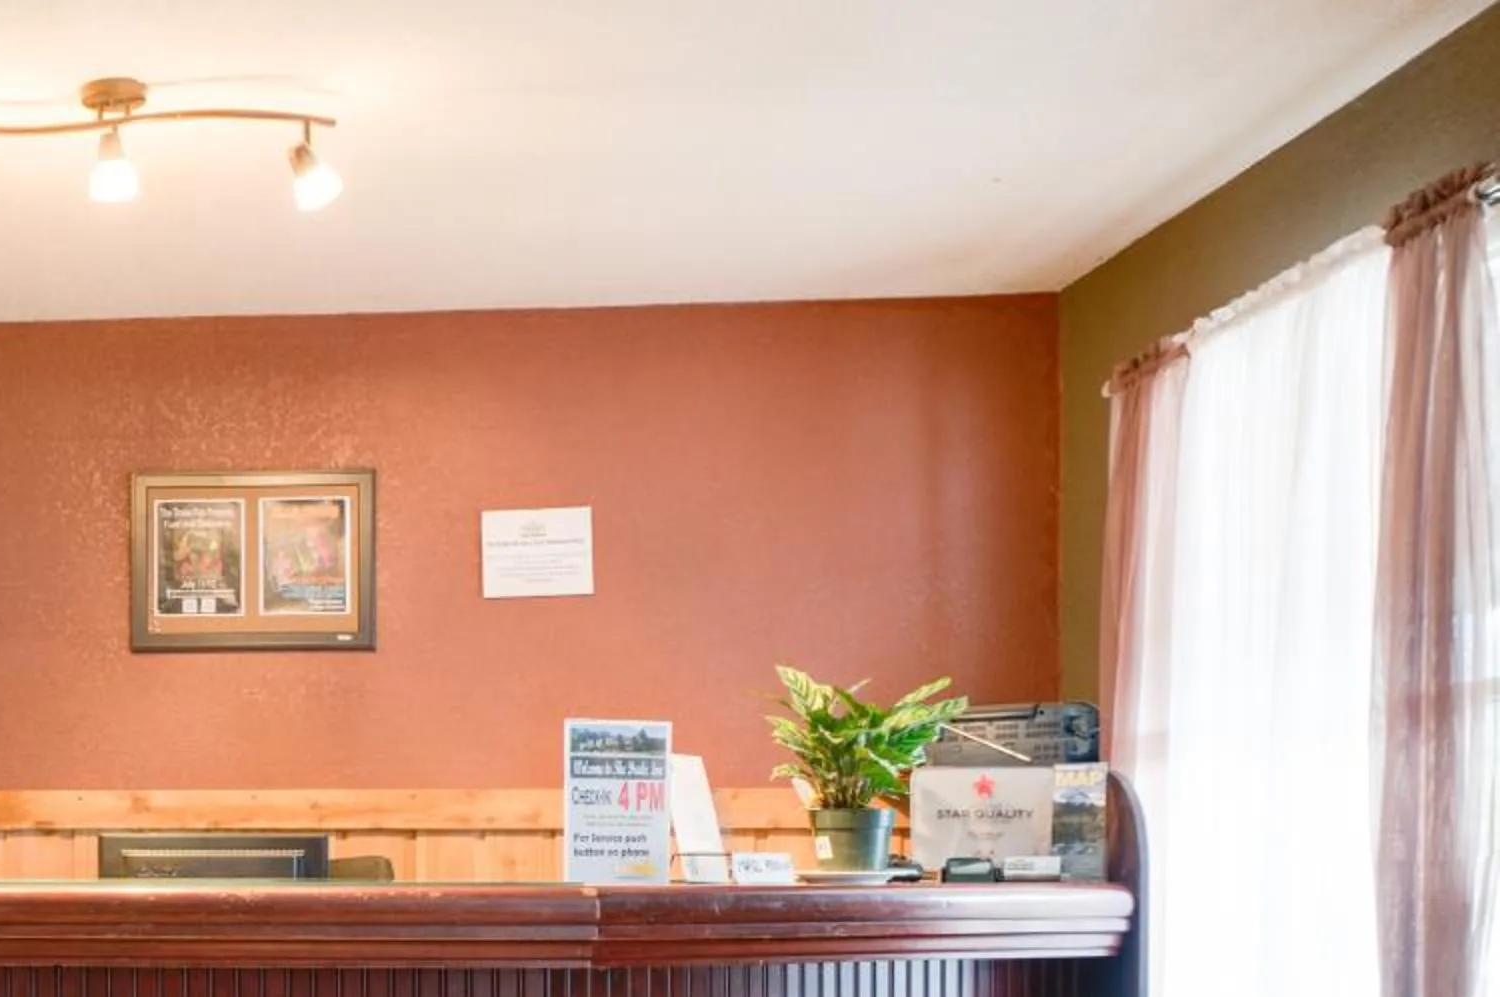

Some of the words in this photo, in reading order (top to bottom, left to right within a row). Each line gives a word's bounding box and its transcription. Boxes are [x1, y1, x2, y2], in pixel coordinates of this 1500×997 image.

[617, 781, 629, 812] 4
[636, 781, 665, 812] PM
[937, 809, 971, 819] STAR
[975, 809, 1034, 819] QUALITY
